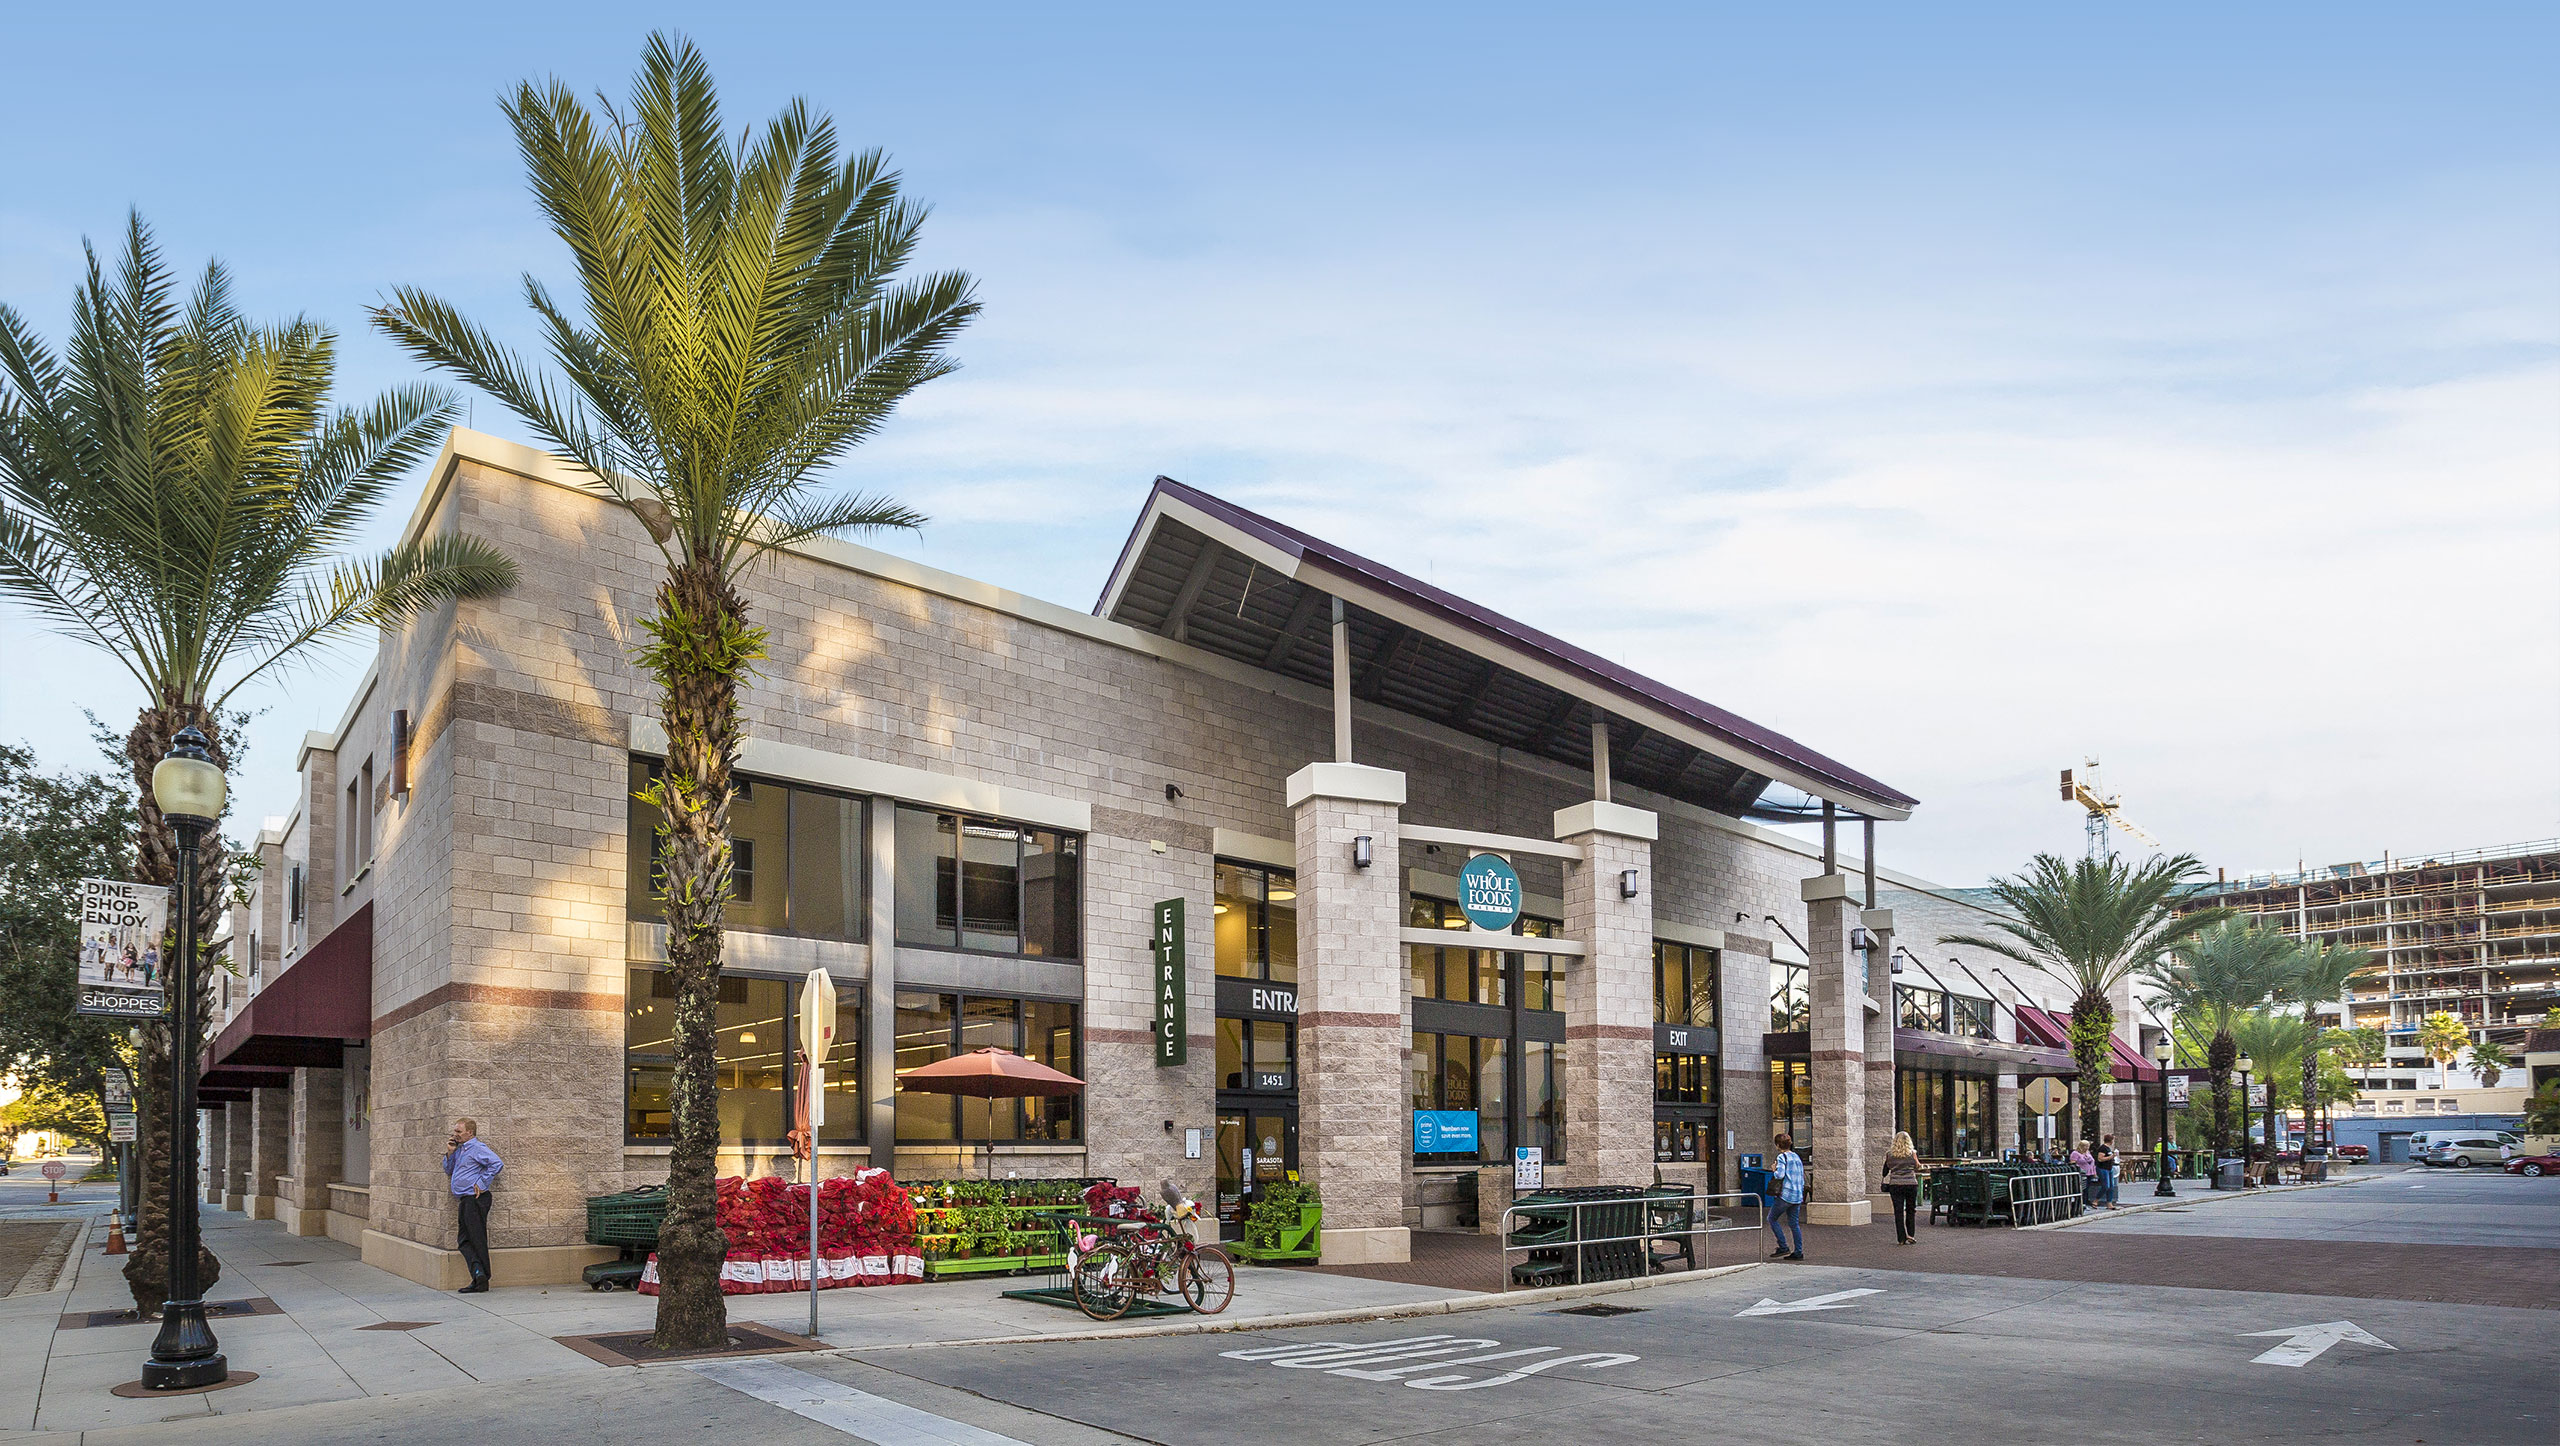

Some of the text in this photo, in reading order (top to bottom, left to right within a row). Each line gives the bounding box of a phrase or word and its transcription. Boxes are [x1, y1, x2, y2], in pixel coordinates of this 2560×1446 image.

[1465, 872, 1513, 892] WHOLE
[87, 883, 137, 899] DINE.
[1469, 889, 1511, 906] FOODS
[86, 897, 140, 914] SHOP.
[86, 911, 149, 929] ENJOY.
[1162, 908, 1174, 1057] ENTRANCE
[82, 995, 160, 1010] SHOPPES
[1670, 1030, 1688, 1046] EXIT
[1262, 1074, 1283, 1086] 1451
[43, 1166, 65, 1175] STOP
[1218, 1335, 1641, 1391] STOP
